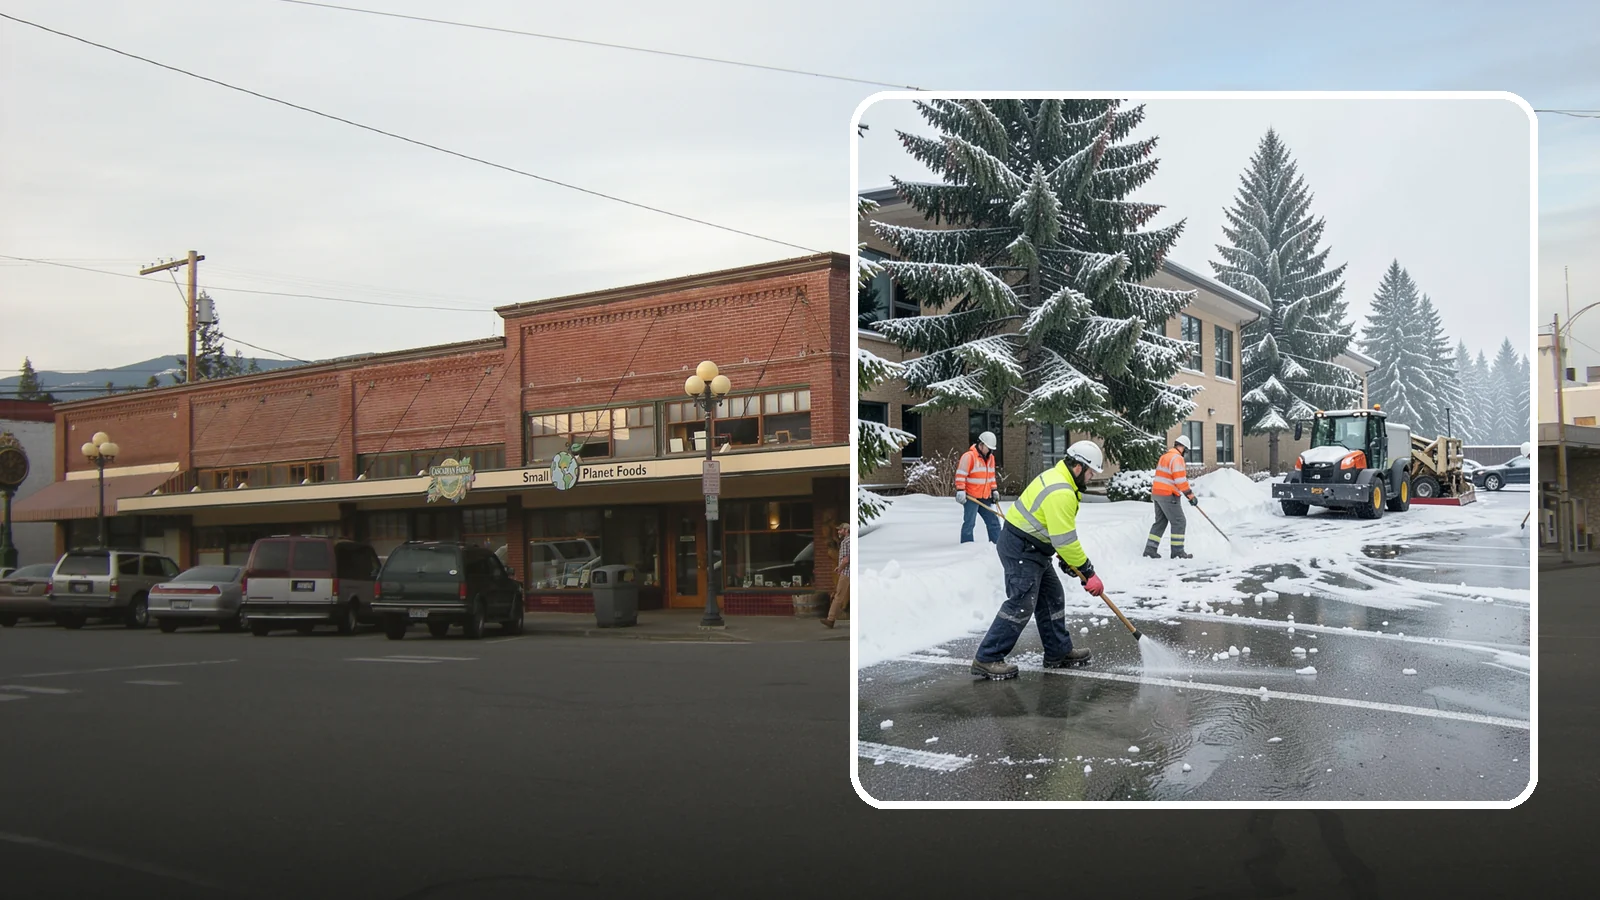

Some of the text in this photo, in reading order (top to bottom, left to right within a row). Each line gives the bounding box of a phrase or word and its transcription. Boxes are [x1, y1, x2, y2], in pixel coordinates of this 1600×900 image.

[522, 464, 647, 483] Small Planet Foods
